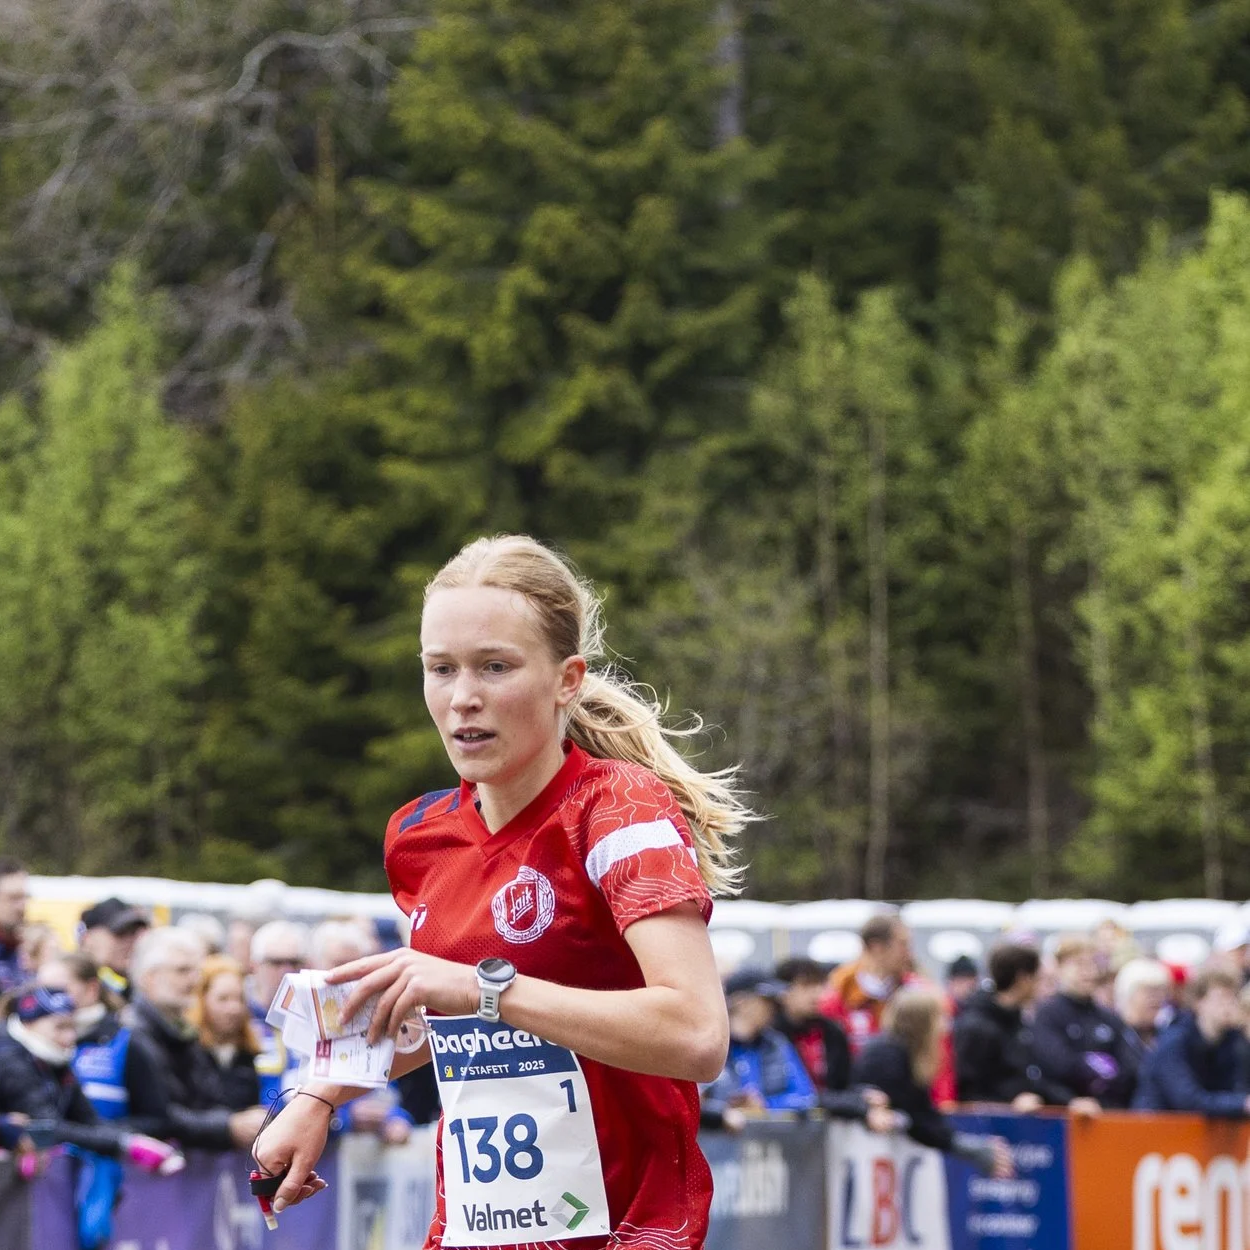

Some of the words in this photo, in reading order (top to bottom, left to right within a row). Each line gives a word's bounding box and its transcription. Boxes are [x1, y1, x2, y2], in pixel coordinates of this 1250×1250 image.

[433, 1028, 559, 1058] bagheer
[468, 1064, 510, 1076] STAFETT
[518, 1060, 546, 1072] 2025
[559, 1079, 577, 1113] 1
[449, 1113, 544, 1183] 138
[462, 1199, 548, 1232] Valmet
[841, 1154, 923, 1248] LBC
